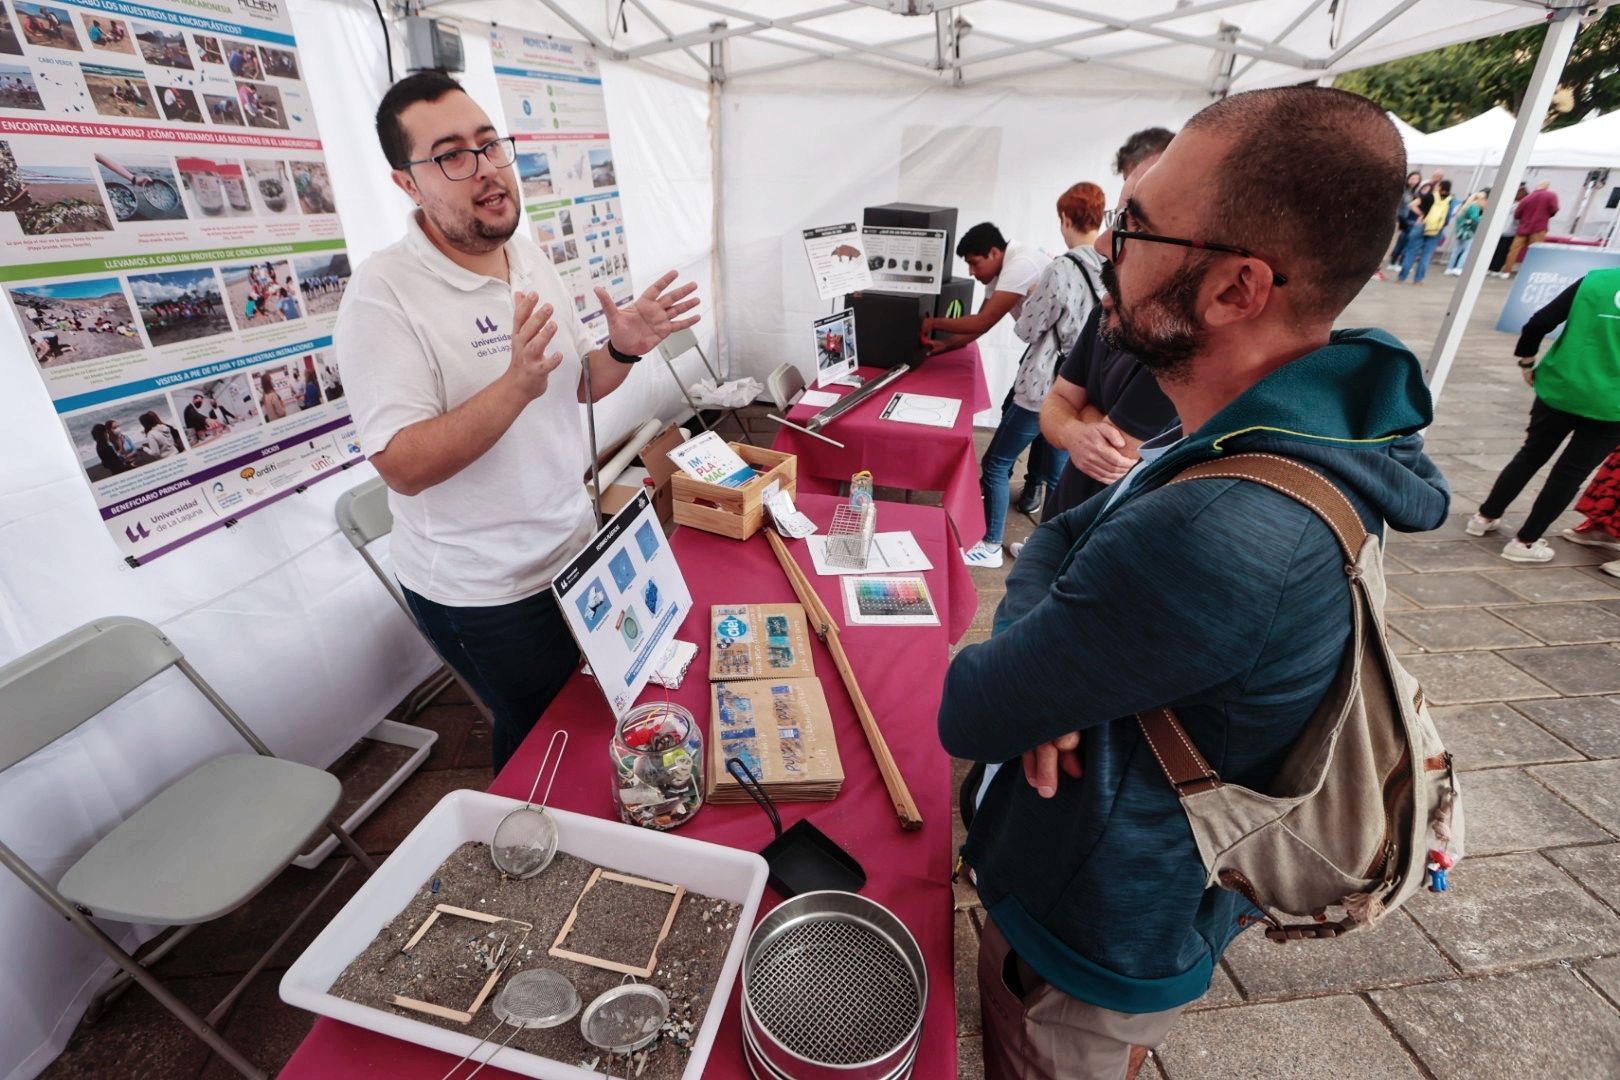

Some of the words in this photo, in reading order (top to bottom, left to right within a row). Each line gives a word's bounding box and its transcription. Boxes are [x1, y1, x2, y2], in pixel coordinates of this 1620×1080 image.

[102, 1, 118, 11] LOS
[120, 4, 167, 21] MUESTREOS
[168, 14, 178, 22] DE
[2, 121, 79, 134] ENCONTRAMOS
[81, 126, 93, 136] EN
[96, 127, 110, 136] LAS
[112, 129, 145, 139] PLAYAS?
[147, 130, 176, 139] ¿CÓMO
[176, 131, 214, 142] TRATAMOS
[215, 134, 228, 143] LAS
[104, 258, 148, 269] LLEVAMOS
[158, 255, 177, 264] CABO
[179, 253, 190, 261] UN
[191, 250, 225, 260] PROYECTO
[227, 249, 235, 257] DE
[471, 334, 512, 348] Universida
[477, 349, 488, 358] de
[498, 344, 512, 353] Lag
[155, 375, 183, 386] VISITAS
[202, 367, 211, 375] DE
[212, 364, 231, 373] PLAYA
[688, 457, 703, 468] IM
[695, 462, 717, 477] PLA
[703, 468, 726, 483] MAC
[110, 491, 158, 515] BENEFICIARIO
[159, 479, 191, 497] PRINCIPAL
[150, 499, 198, 523] Universidad
[156, 523, 167, 533] de
[168, 520, 177, 528] La
[178, 508, 203, 524] Laguna
